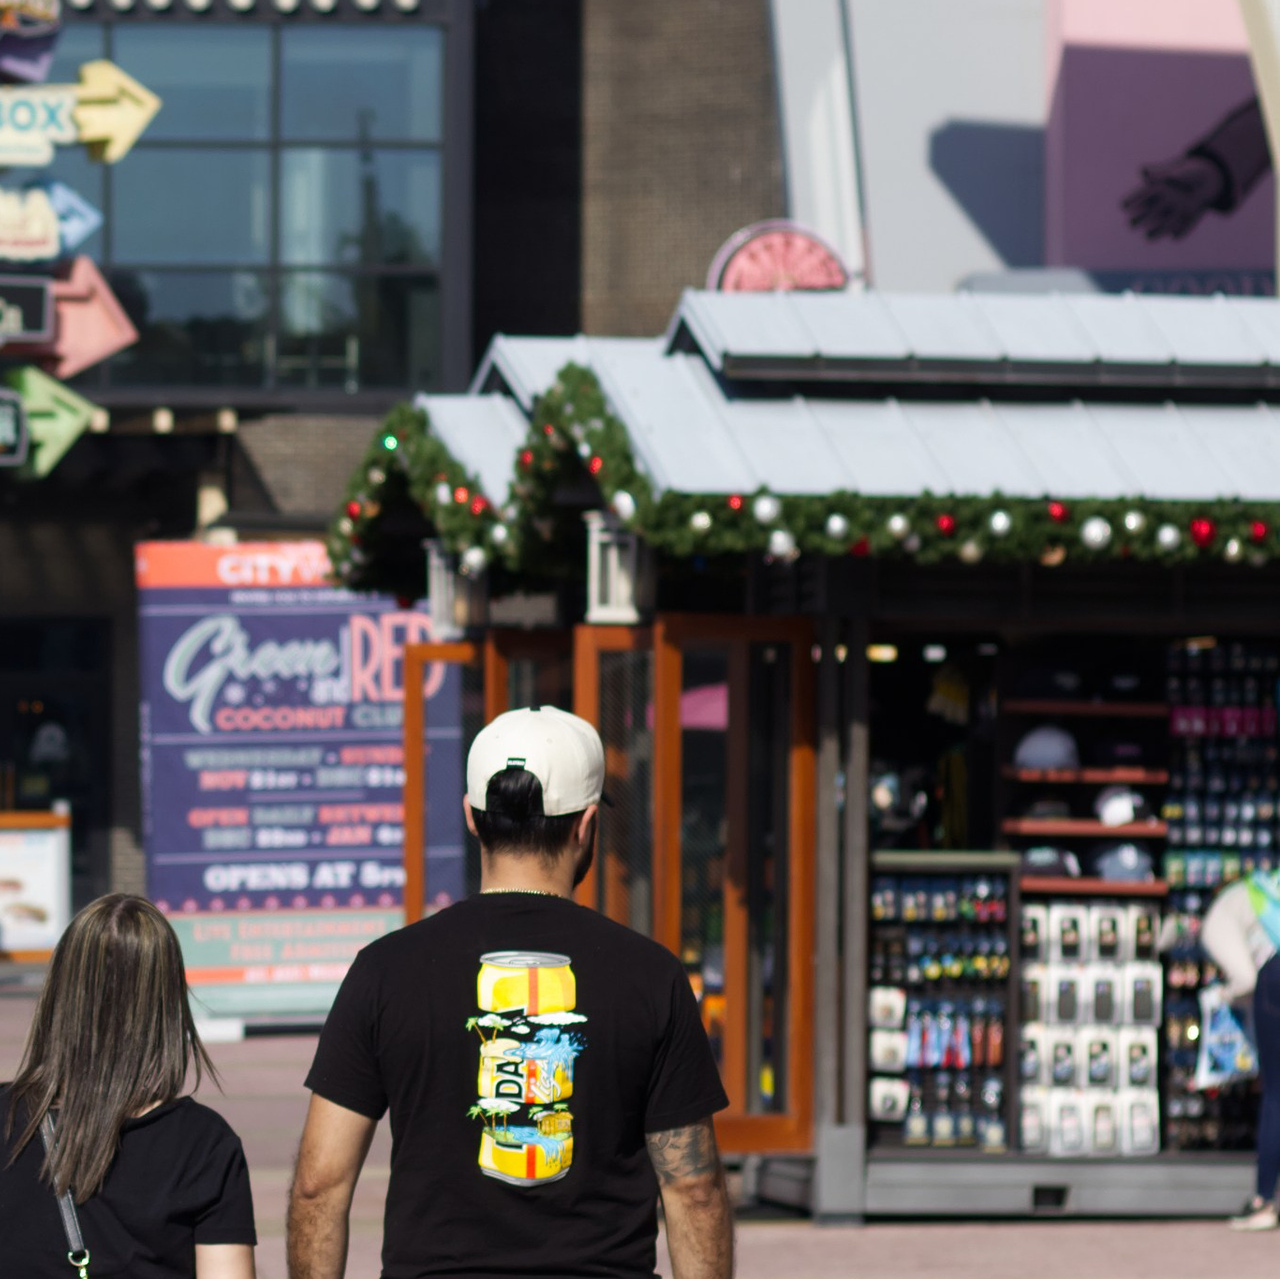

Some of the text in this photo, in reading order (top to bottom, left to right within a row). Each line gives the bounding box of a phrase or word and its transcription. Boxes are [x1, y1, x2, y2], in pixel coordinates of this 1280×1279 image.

[216, 703, 405, 731] COCONUT CLU
[204, 863, 309, 893] OPENS
[312, 861, 357, 890] AT
